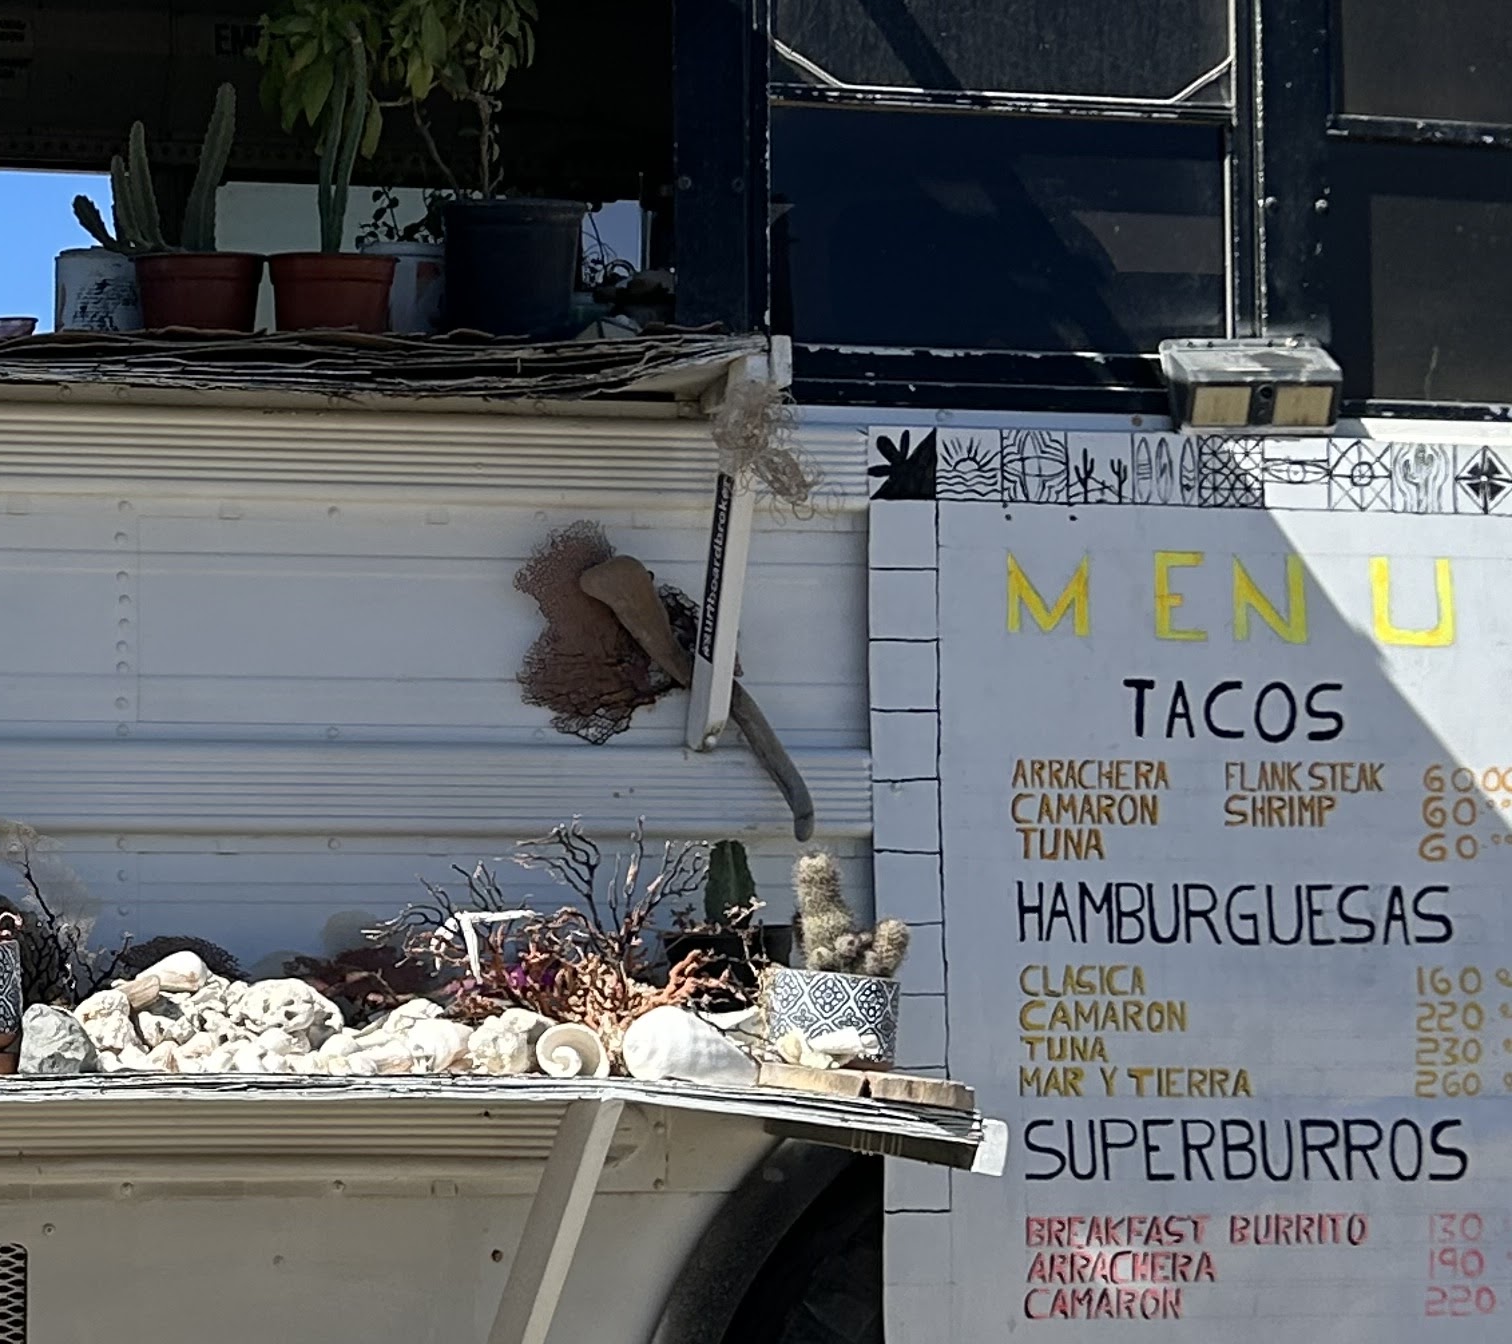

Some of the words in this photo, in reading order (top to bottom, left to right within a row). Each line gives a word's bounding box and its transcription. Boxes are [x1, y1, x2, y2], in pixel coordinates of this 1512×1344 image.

[1124, 678, 1344, 743] TACOS
[1011, 759, 1169, 791] ARRACHERA
[1011, 793, 1159, 826] CAMARON
[1224, 794, 1336, 827] SHRIMP
[1015, 827, 1105, 861] TUNA
[1017, 880, 1453, 946] HAMBURGUESAS
[1019, 964, 1145, 998] CLASICA
[1019, 999, 1187, 1033] CAMARON
[1019, 1036, 1108, 1064] TUNA
[1019, 1066, 1084, 1097] MAR
[1100, 1066, 1118, 1097] Y
[1127, 1067, 1253, 1097] TIERRA
[1024, 1118, 1468, 1181] SUPERBURROS
[1025, 1215, 1208, 1246] BREAKFAST
[1229, 1213, 1369, 1246] BURRITO
[1026, 1248, 1217, 1283] ARRACHERA
[1023, 1287, 1182, 1320] CAMARON
